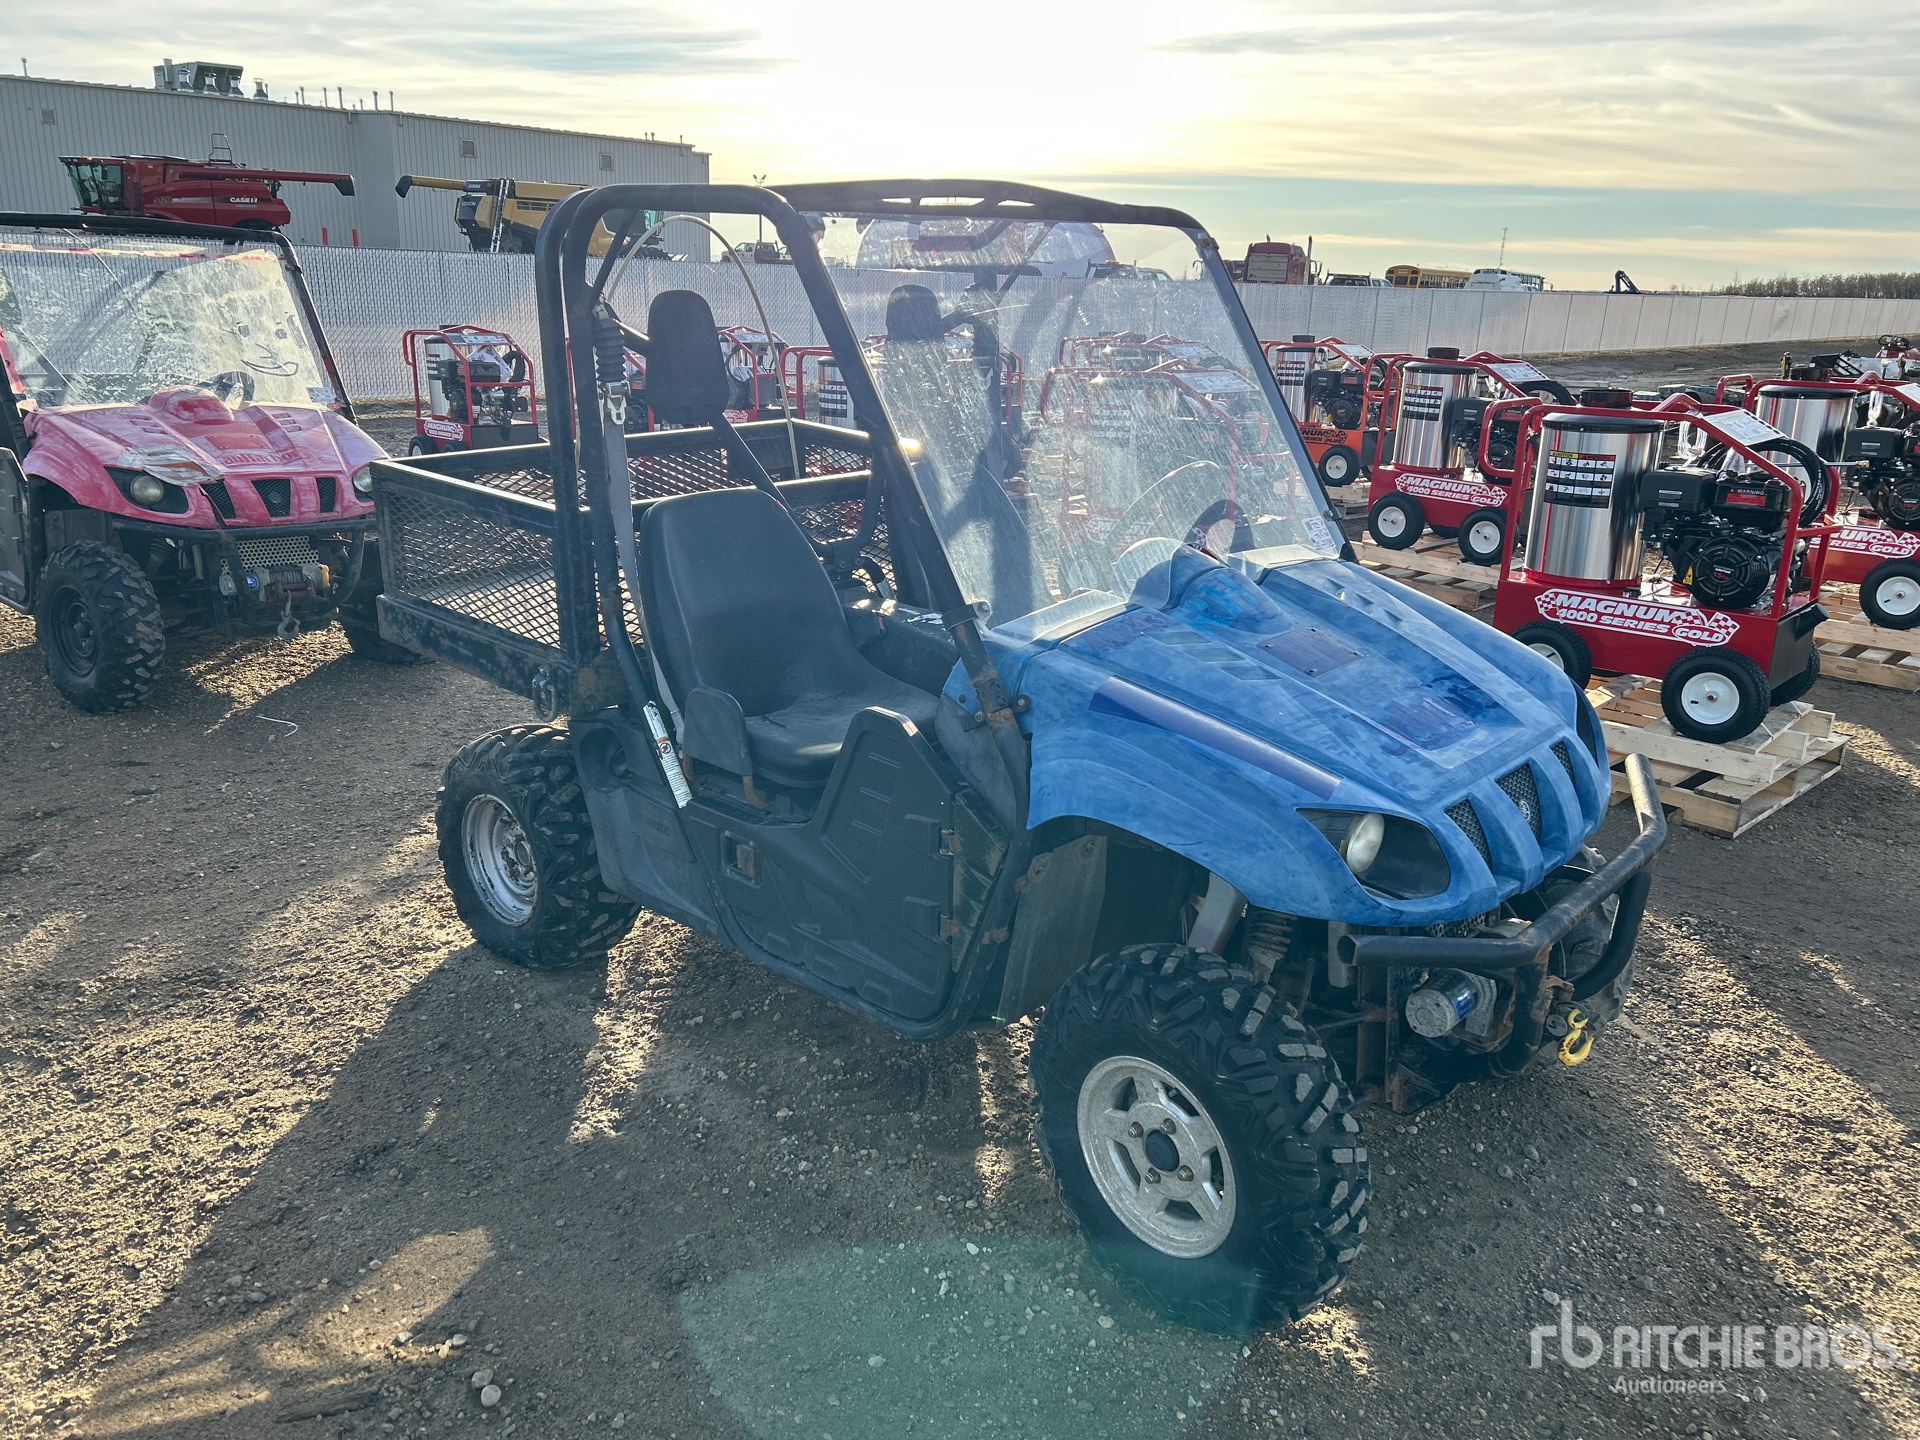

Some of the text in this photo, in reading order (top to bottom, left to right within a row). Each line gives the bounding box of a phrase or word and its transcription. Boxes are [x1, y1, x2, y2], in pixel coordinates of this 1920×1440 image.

[1406, 476, 1477, 494] MAGNUM
[1407, 485, 1499, 505] 4000 SERIES GOLD
[1809, 537, 1911, 555] SRIES GOLD
[1556, 594, 1681, 624] MAGNUM
[1558, 608, 1725, 642] 4000 SERIES GOLD
